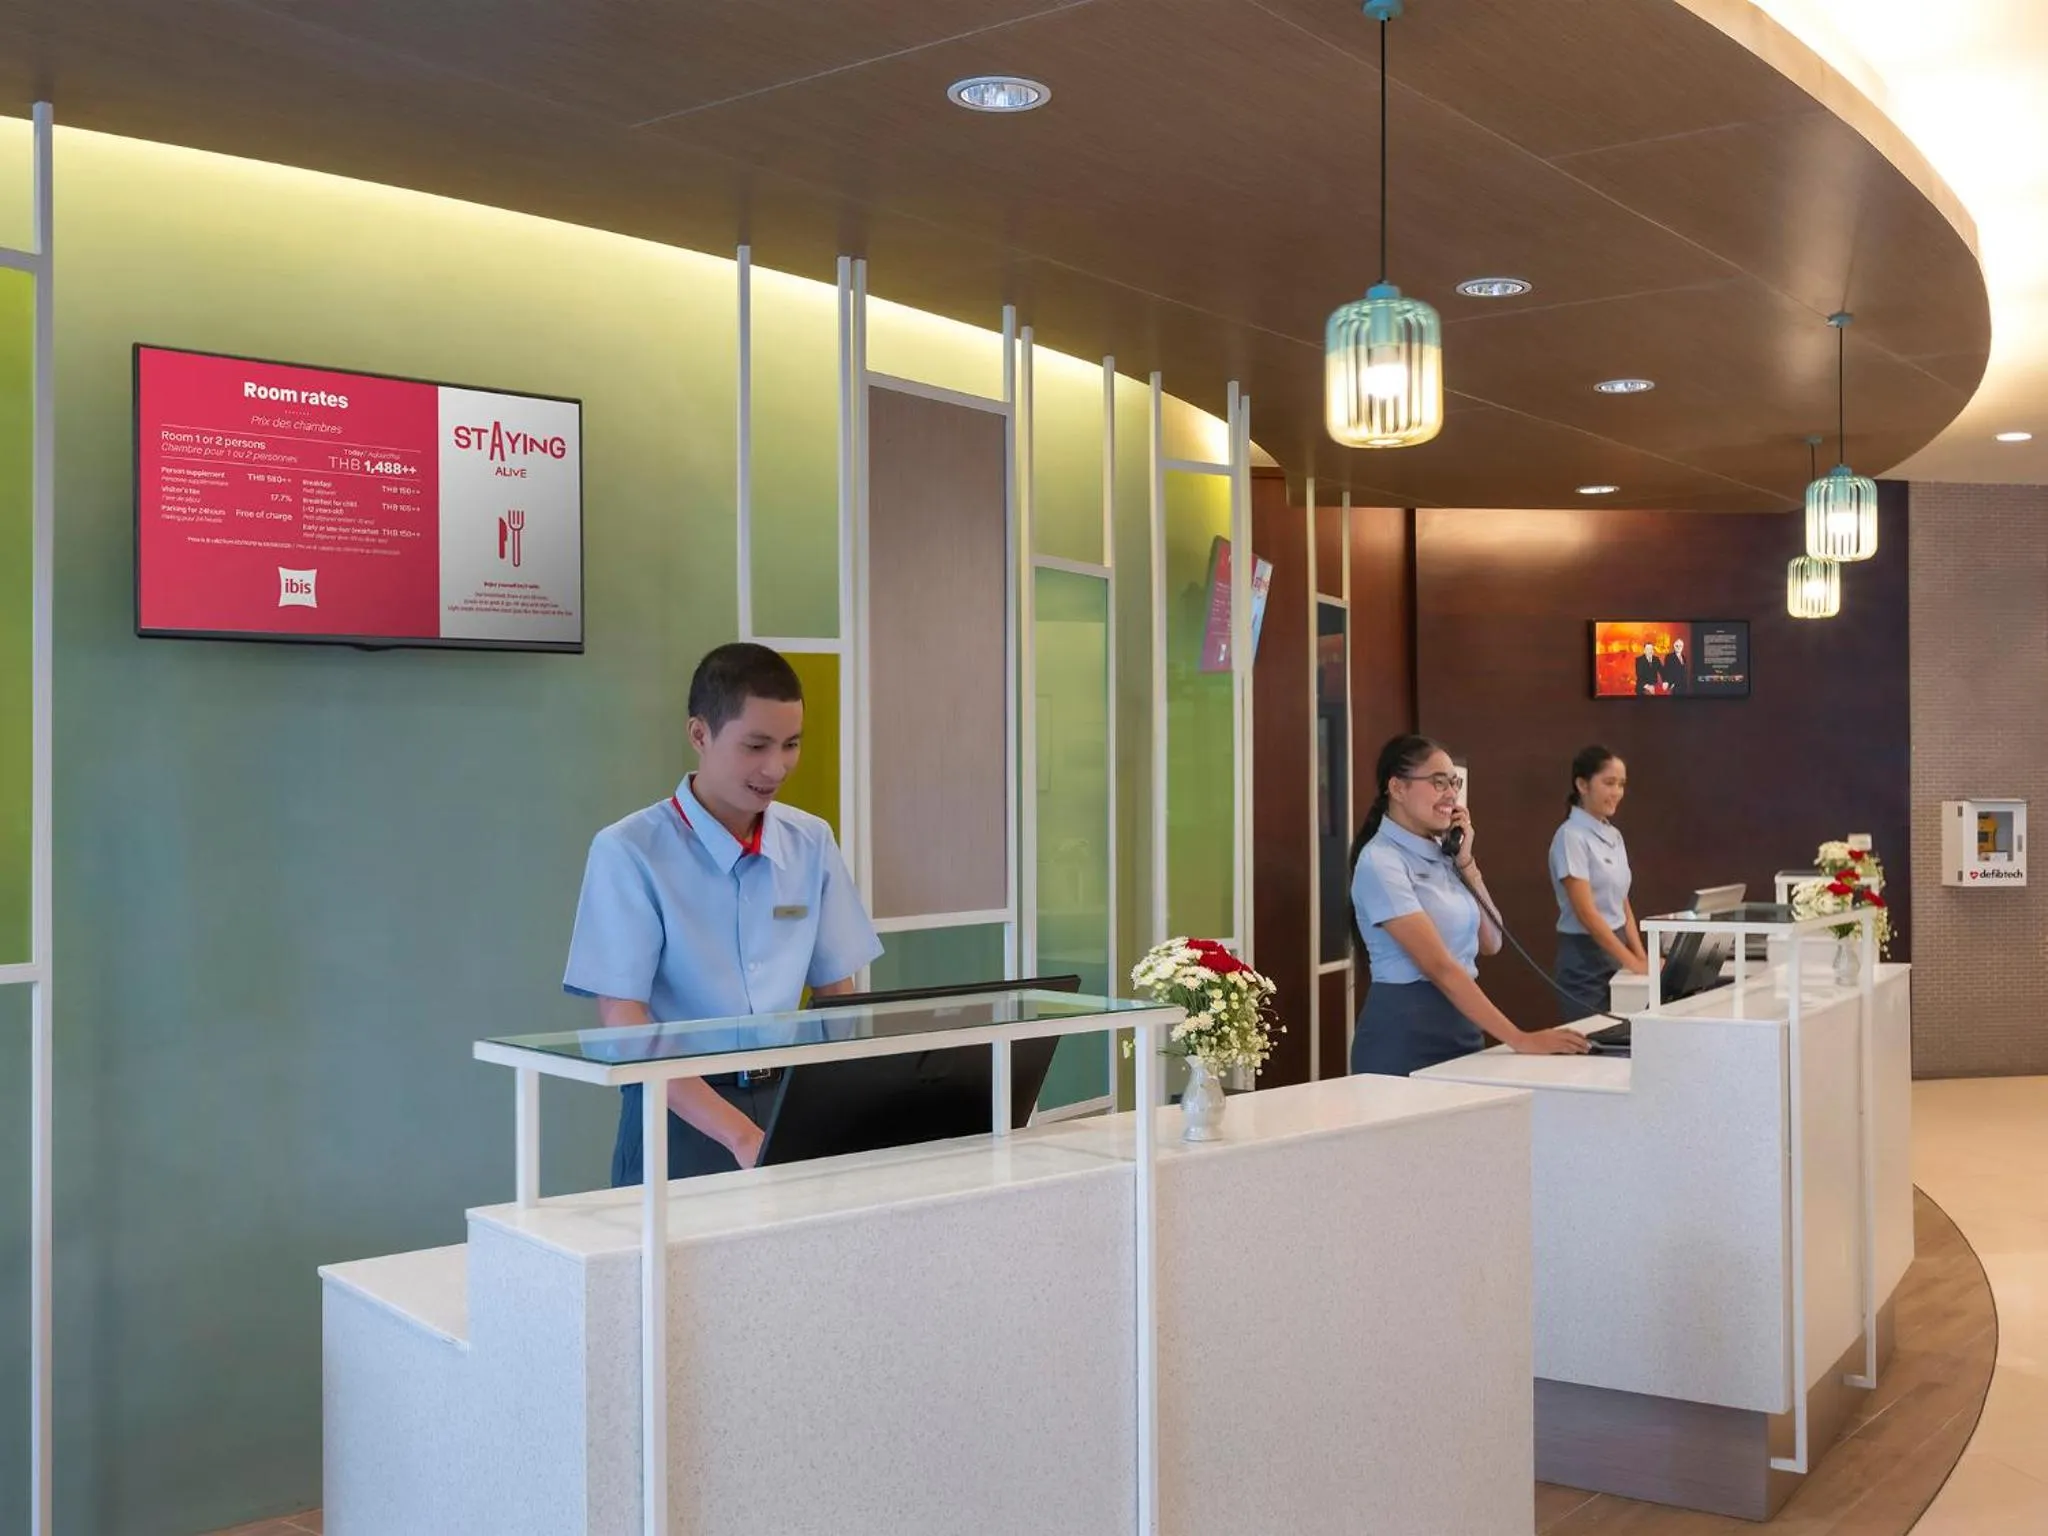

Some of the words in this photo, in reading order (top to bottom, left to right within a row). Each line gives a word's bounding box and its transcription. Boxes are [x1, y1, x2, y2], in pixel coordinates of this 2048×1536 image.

[244, 381, 298, 403] Room
[301, 390, 349, 409] rates
[250, 415, 270, 427] Prix
[272, 417, 292, 430] des
[293, 419, 343, 434] chambres
[161, 430, 194, 443] Room
[196, 434, 201, 443] 1
[202, 436, 214, 445] or
[215, 436, 223, 446] 2
[224, 438, 267, 450] persons
[161, 441, 203, 455] Chambre
[453, 421, 567, 462] STAYING
[328, 455, 361, 471] THB
[363, 460, 417, 475] 1,488++
[495, 466, 527, 479] ALIVE
[235, 509, 255, 518] Free
[255, 510, 265, 518] of
[265, 512, 293, 522] charge
[284, 577, 312, 595] ibis
[1979, 868, 2024, 879] defibtech
